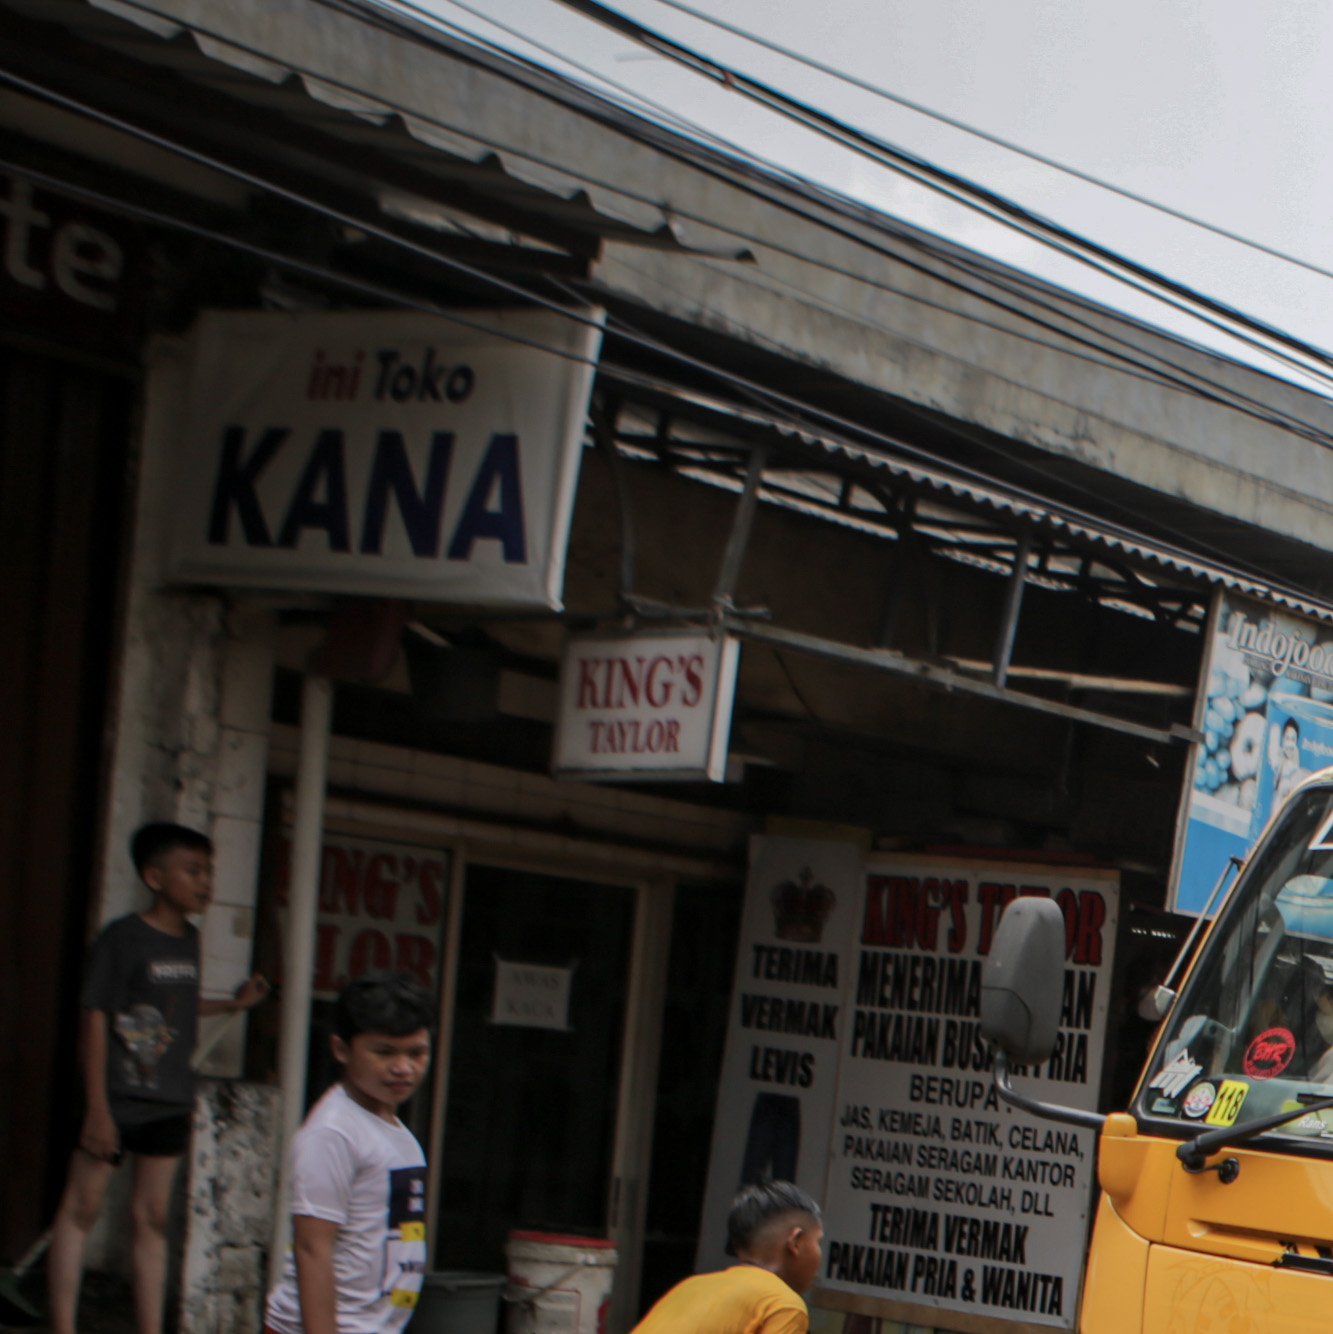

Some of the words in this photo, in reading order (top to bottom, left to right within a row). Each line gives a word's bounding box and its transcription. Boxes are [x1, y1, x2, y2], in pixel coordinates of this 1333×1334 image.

[307, 347, 367, 400] ini
[374, 347, 475, 404] Toko
[207, 426, 528, 564] KANA
[577, 655, 704, 709] KING'S
[589, 720, 681, 754] TAYLOR
[862, 873, 968, 954] KING'S
[753, 944, 838, 989] TERIMA
[857, 951, 982, 1018] MENERIMA
[742, 993, 838, 1040] VERMAK
[750, 1045, 815, 1088] LEVIS
[851, 1010, 939, 1066] PAKAIAN
[1033, 1031, 1089, 1084] RIA
[910, 1074, 999, 1112] BERUPA
[1212, 1086, 1245, 1122] 118
[843, 1135, 913, 1166] PAKAIAN
[916, 1145, 998, 1177] SERAGAM
[1002, 1156, 1076, 1188] KANTOR
[878, 1110, 946, 1142] KEMEJA,
[950, 1118, 1003, 1149] BATIK,
[1008, 1125, 1085, 1161] CELANA,
[851, 1166, 930, 1201] SERAGAM
[933, 1177, 1016, 1215] SEKOLAH,
[1021, 1190, 1054, 1217] DLL
[869, 1203, 940, 1251] TERIMA
[944, 1214, 1029, 1265] VERMAK
[826, 1241, 910, 1291] PAKAIAN
[911, 1253, 958, 1299] PRIA
[961, 1268, 977, 1303] &
[982, 1265, 1064, 1316] WANITA
